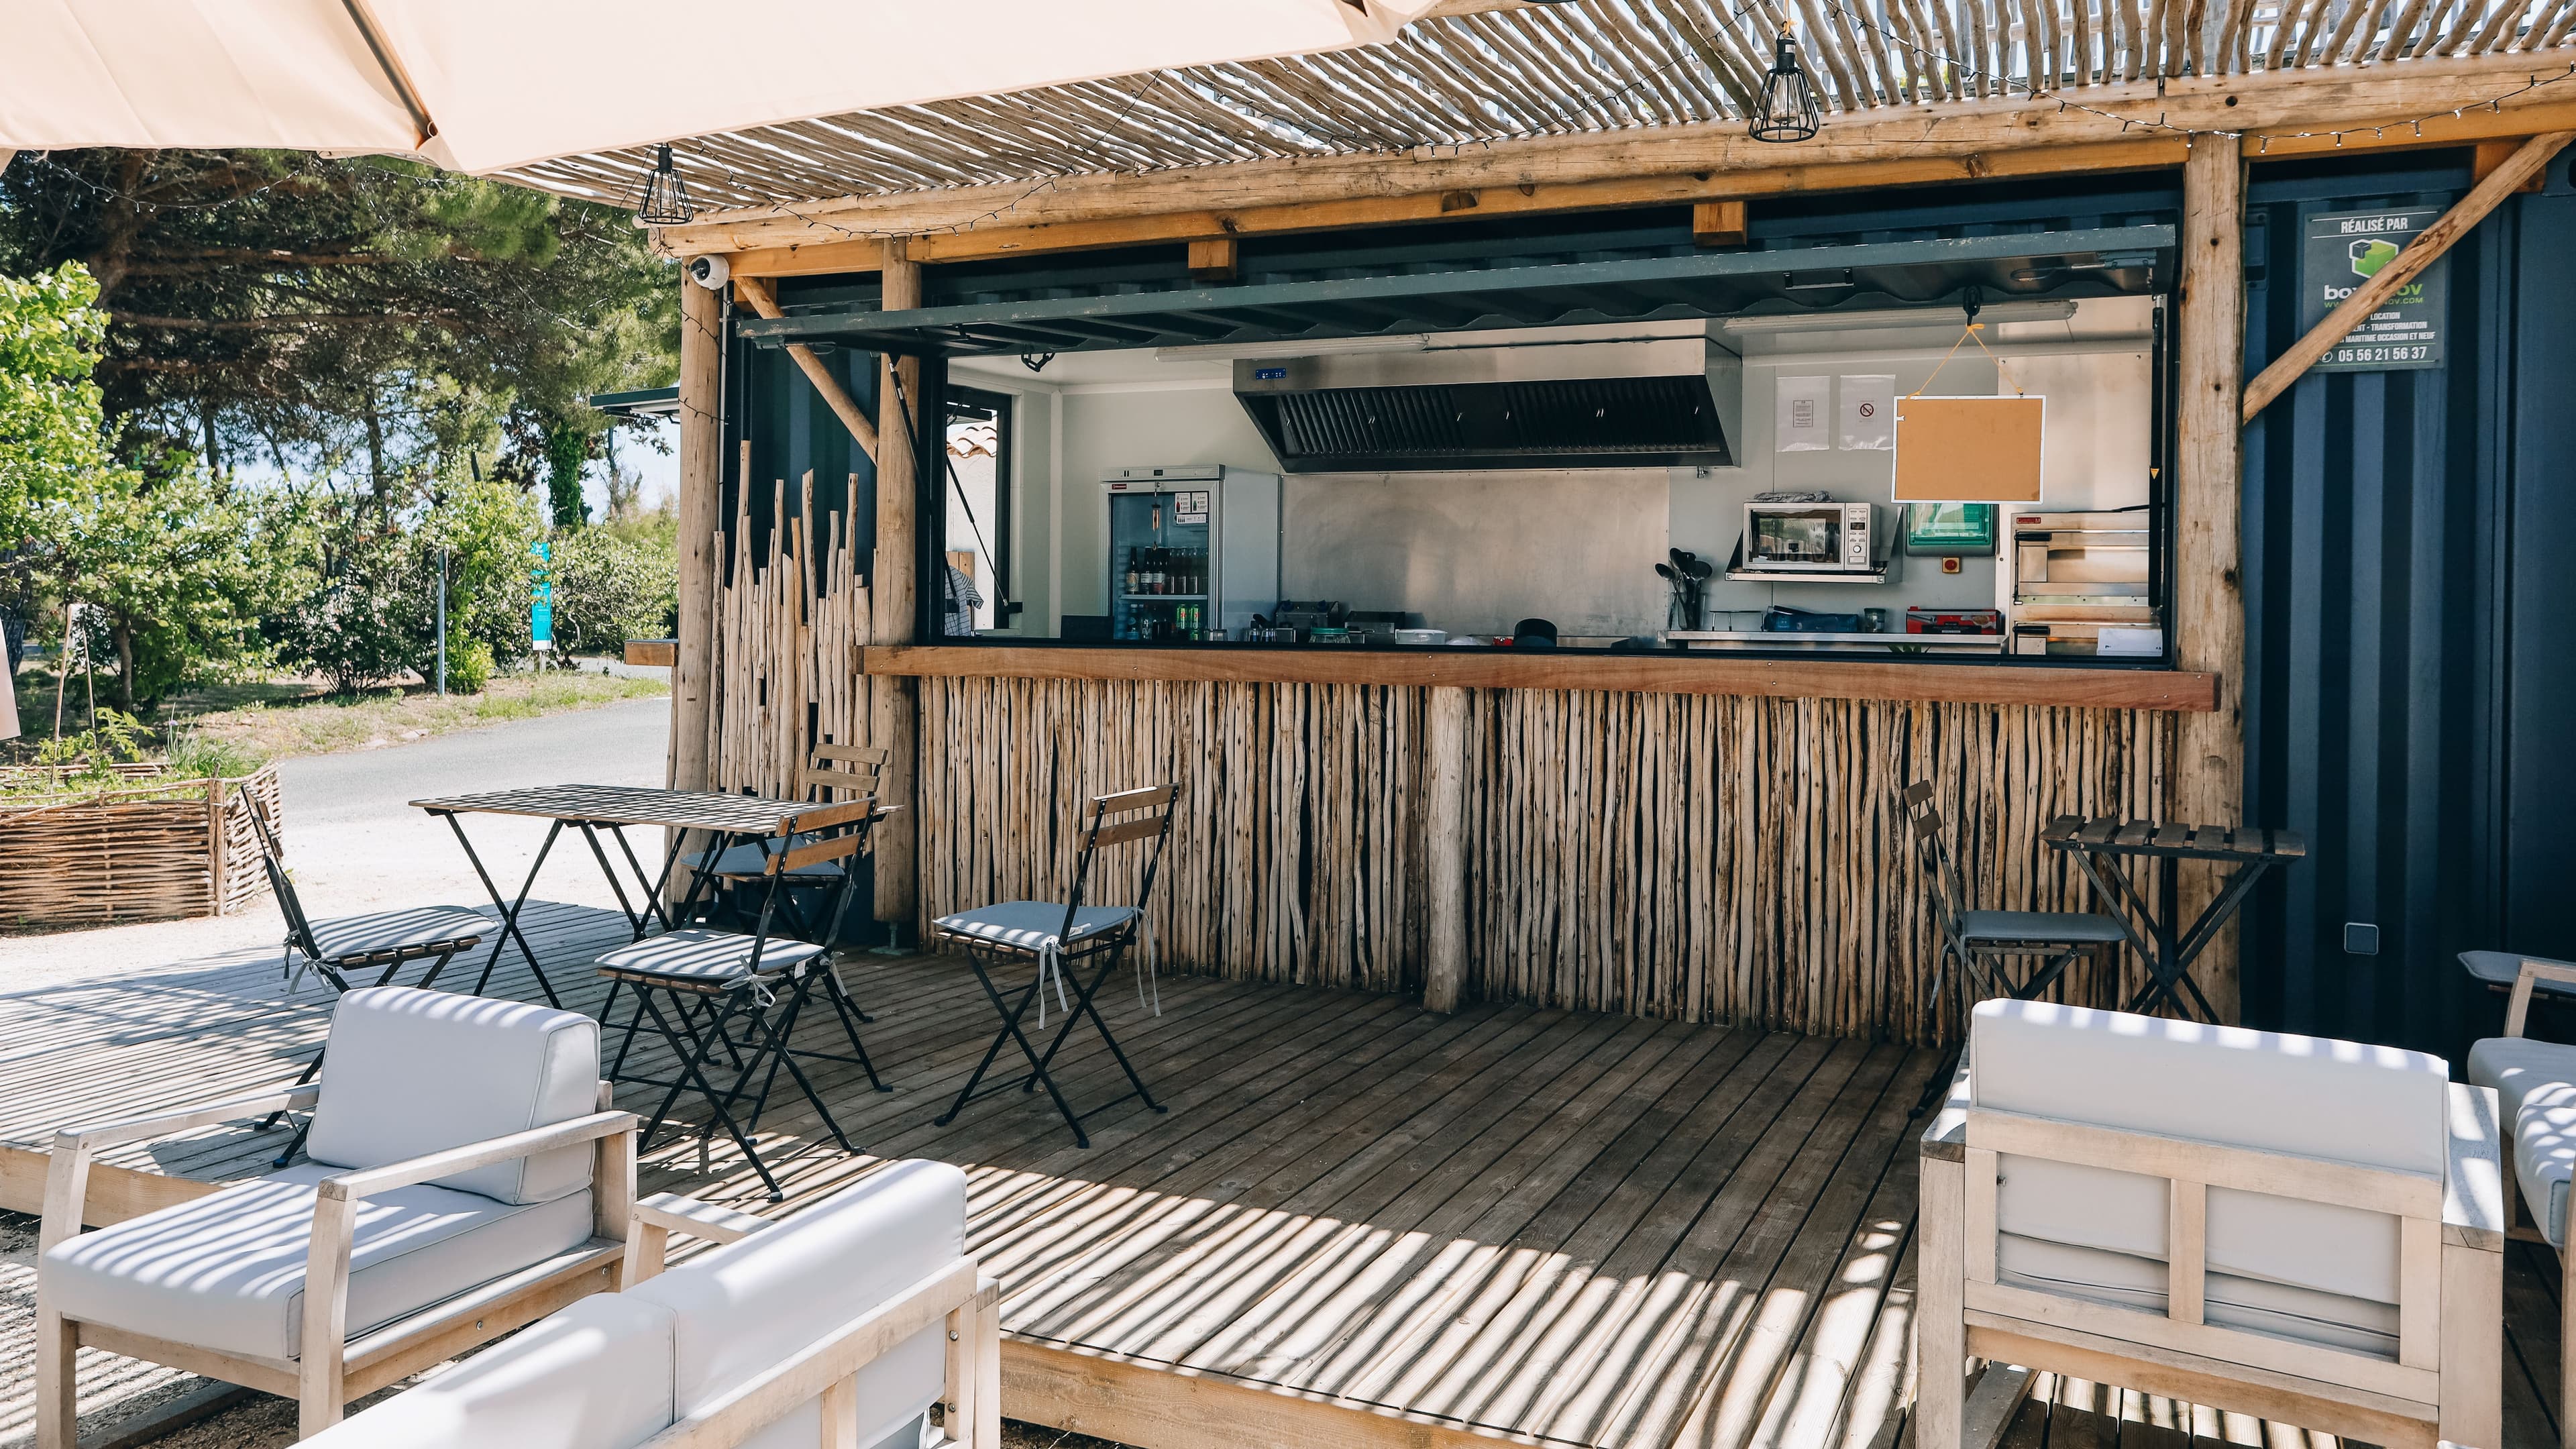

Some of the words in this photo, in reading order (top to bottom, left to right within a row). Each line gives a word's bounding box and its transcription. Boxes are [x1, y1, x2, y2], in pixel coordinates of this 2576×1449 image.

[2341, 217, 2384, 233] RÉALISÉ
[2386, 217, 2408, 230] PAR
[2370, 312, 2400, 321] LOCATION
[2371, 321, 2428, 331] TRANSFORMATION
[2345, 334, 2376, 343] MARITIME
[2377, 333, 2408, 341] OCCASION
[2418, 331, 2436, 339] NEUF
[2338, 350, 2353, 362] 05
[2357, 348, 2372, 361] 56
[2375, 347, 2389, 360] 21
[2393, 347, 2408, 360] 56
[2411, 346, 2427, 359] 37
